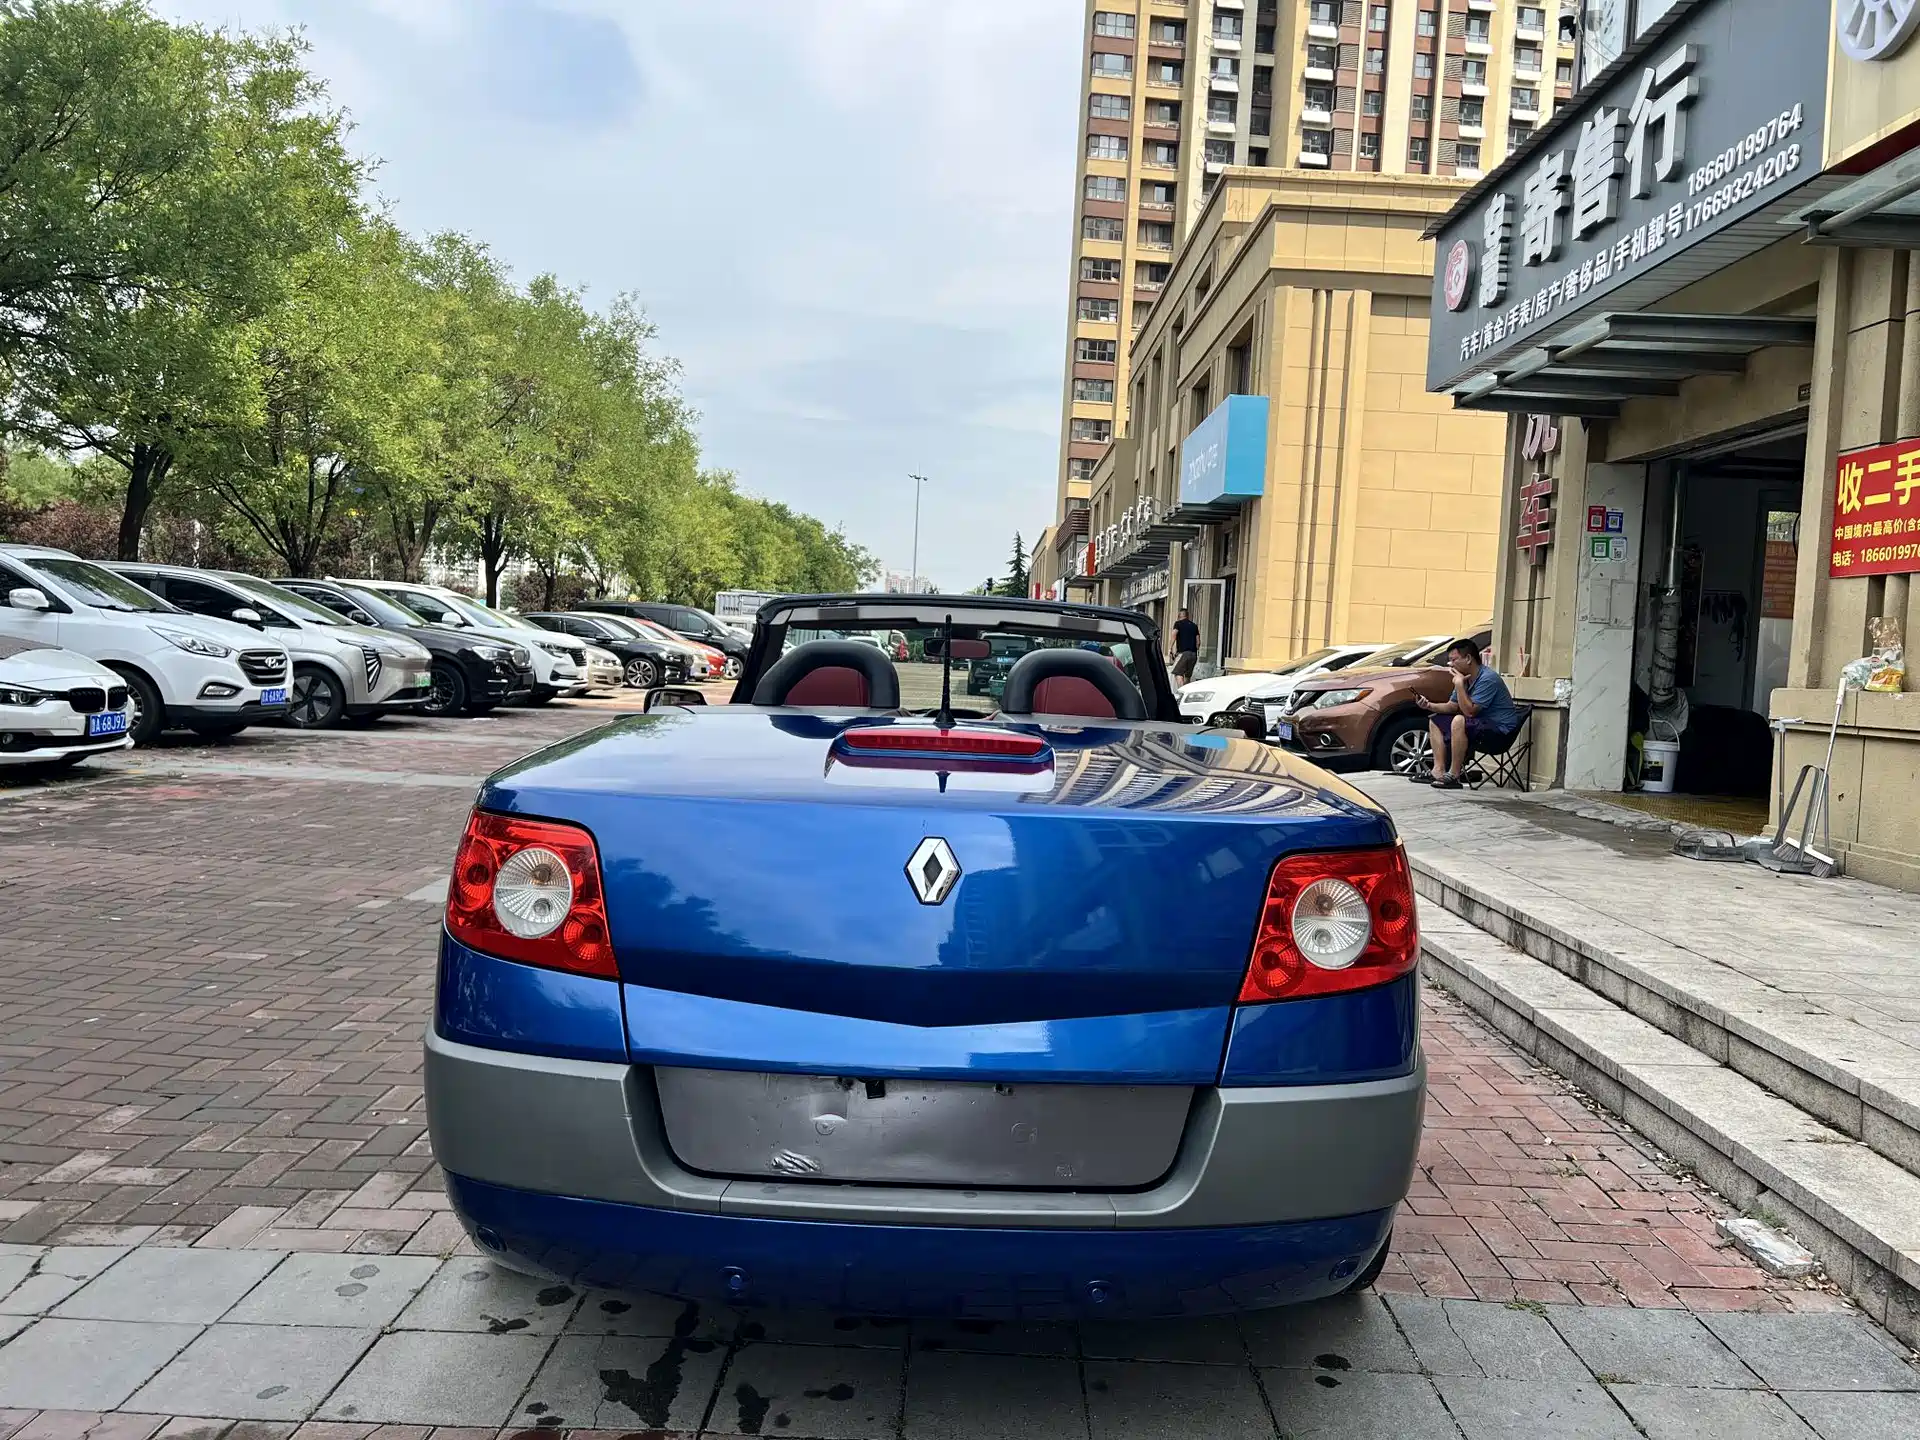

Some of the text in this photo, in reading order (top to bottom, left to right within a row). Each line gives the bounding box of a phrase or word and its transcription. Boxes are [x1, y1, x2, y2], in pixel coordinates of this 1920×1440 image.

[1685, 143, 1801, 232] 17669324203
[1687, 102, 1803, 197] 18660199764
[1837, 449, 1920, 515] 收二手
